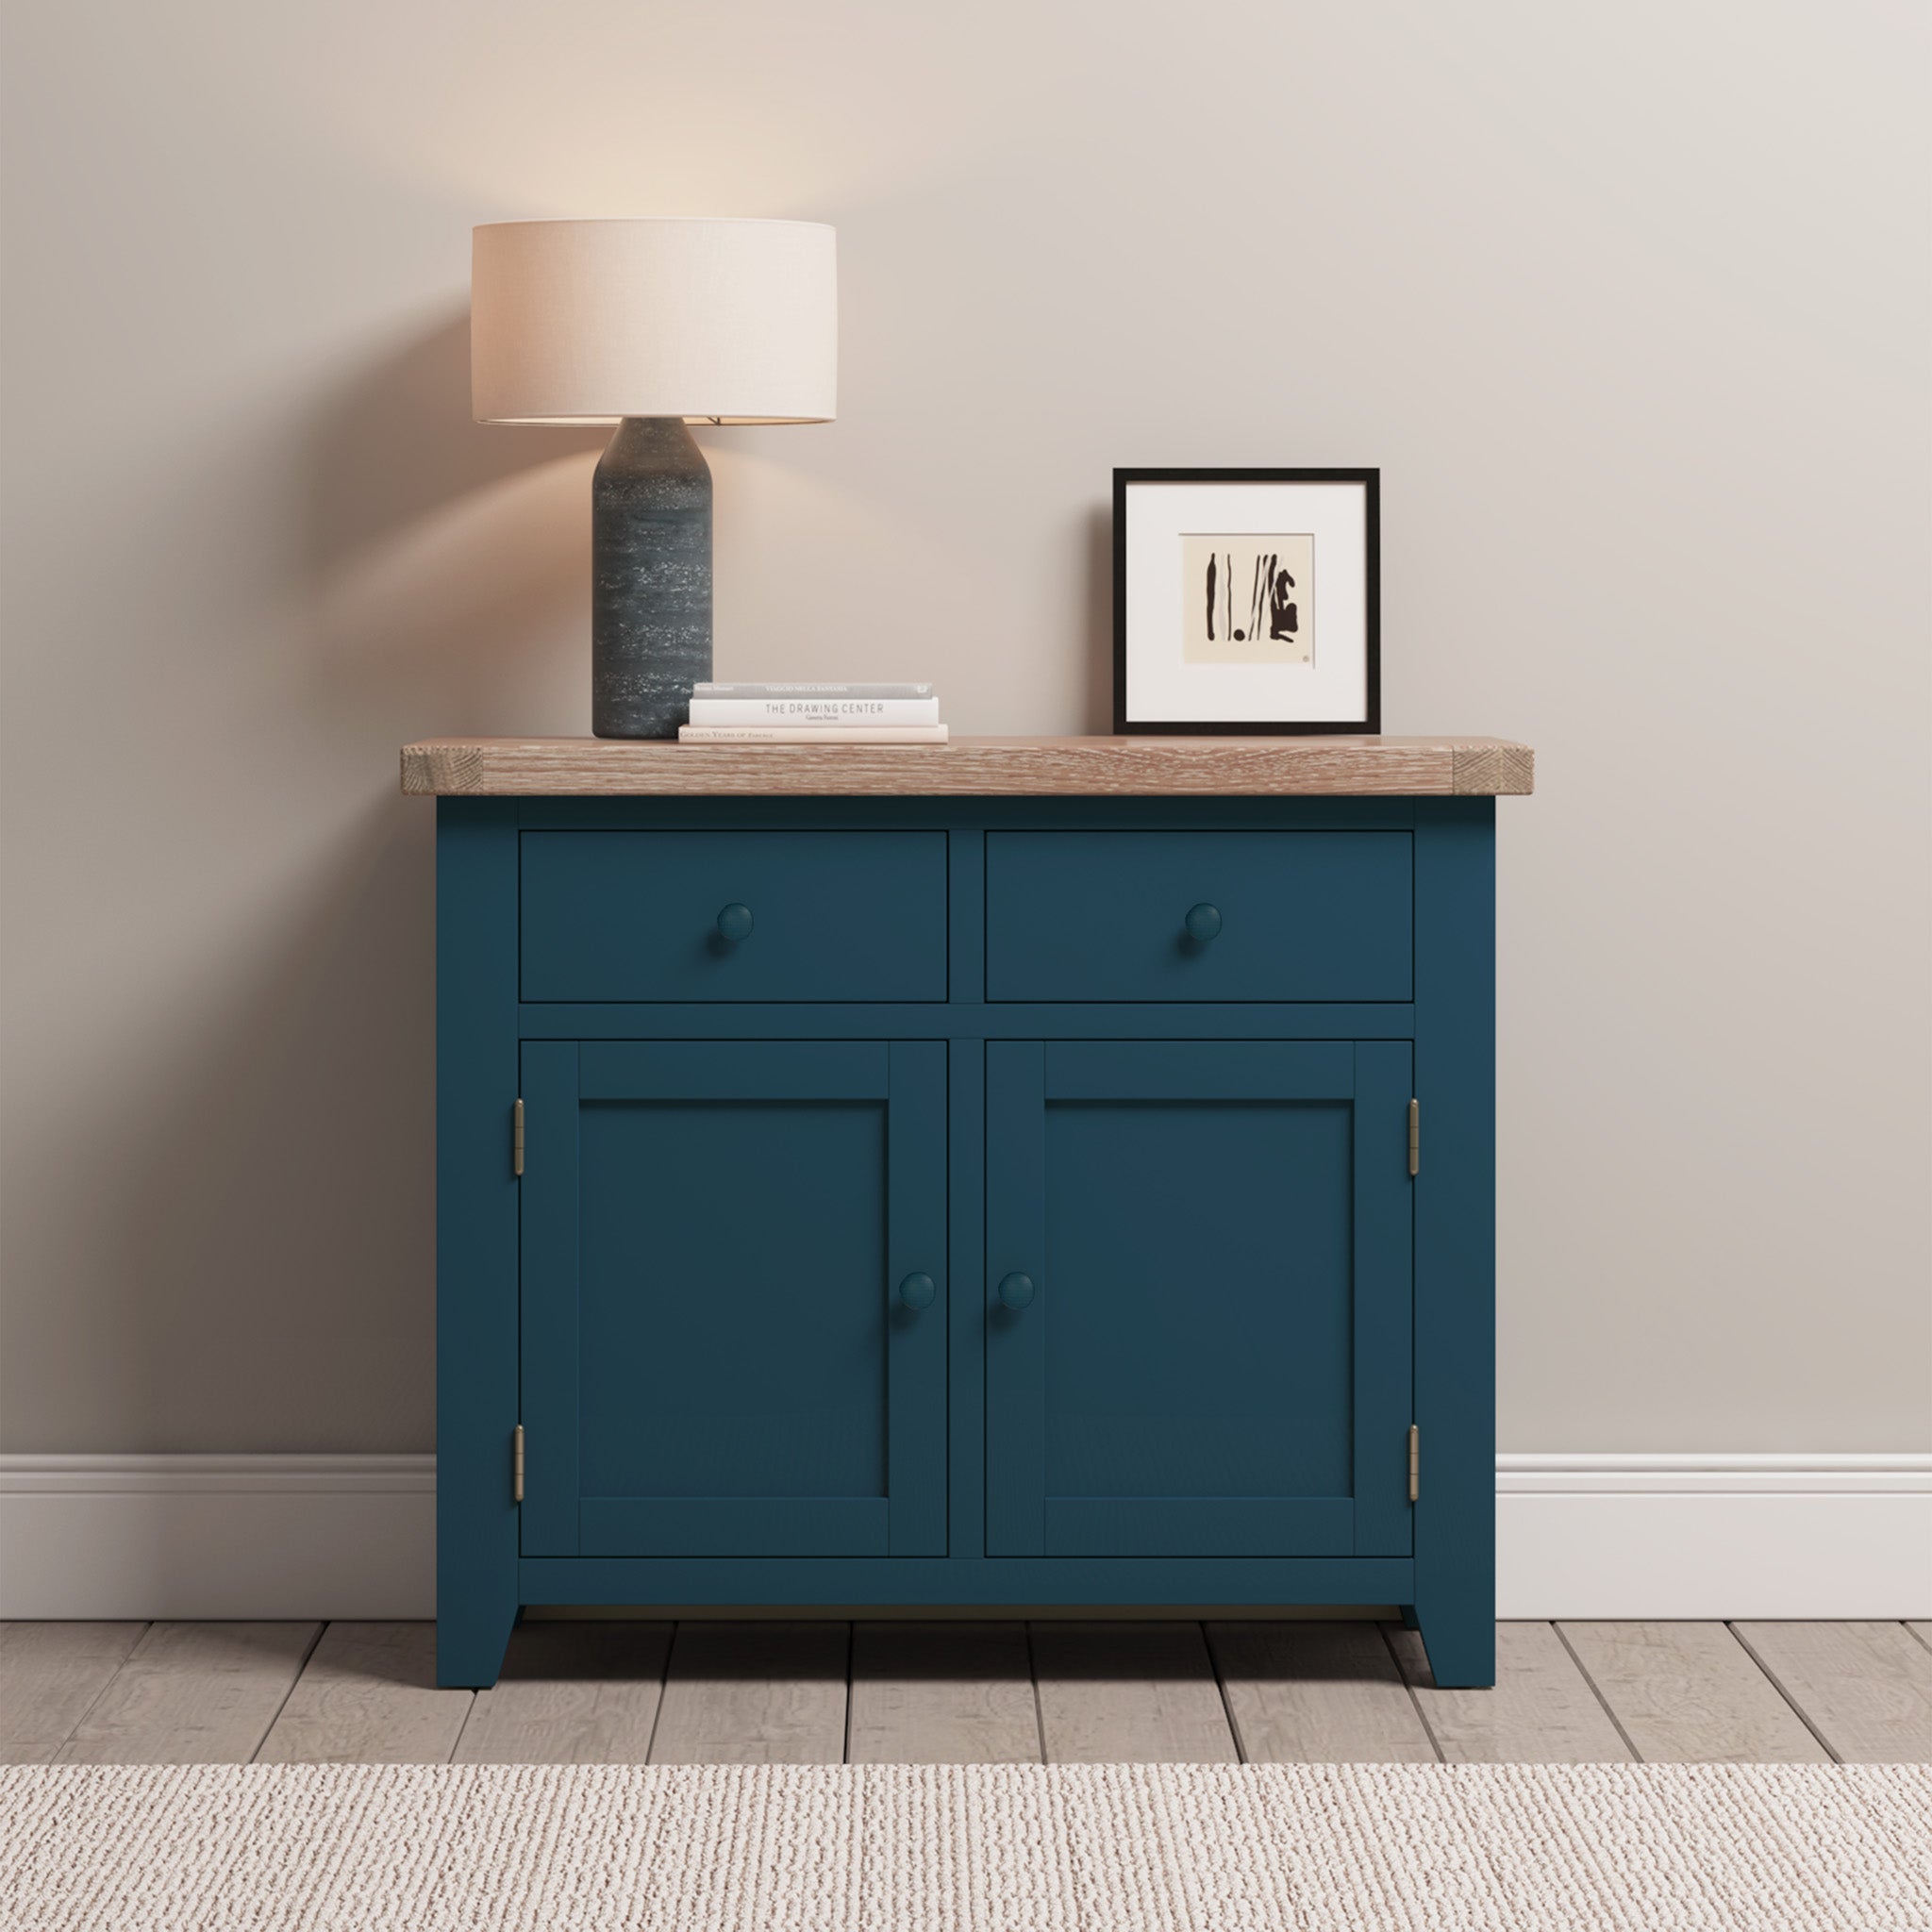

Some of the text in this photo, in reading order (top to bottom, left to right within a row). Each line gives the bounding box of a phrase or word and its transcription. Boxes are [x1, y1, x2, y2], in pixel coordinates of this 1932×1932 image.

[766, 703, 884, 714] THE DRAWING CENTER
